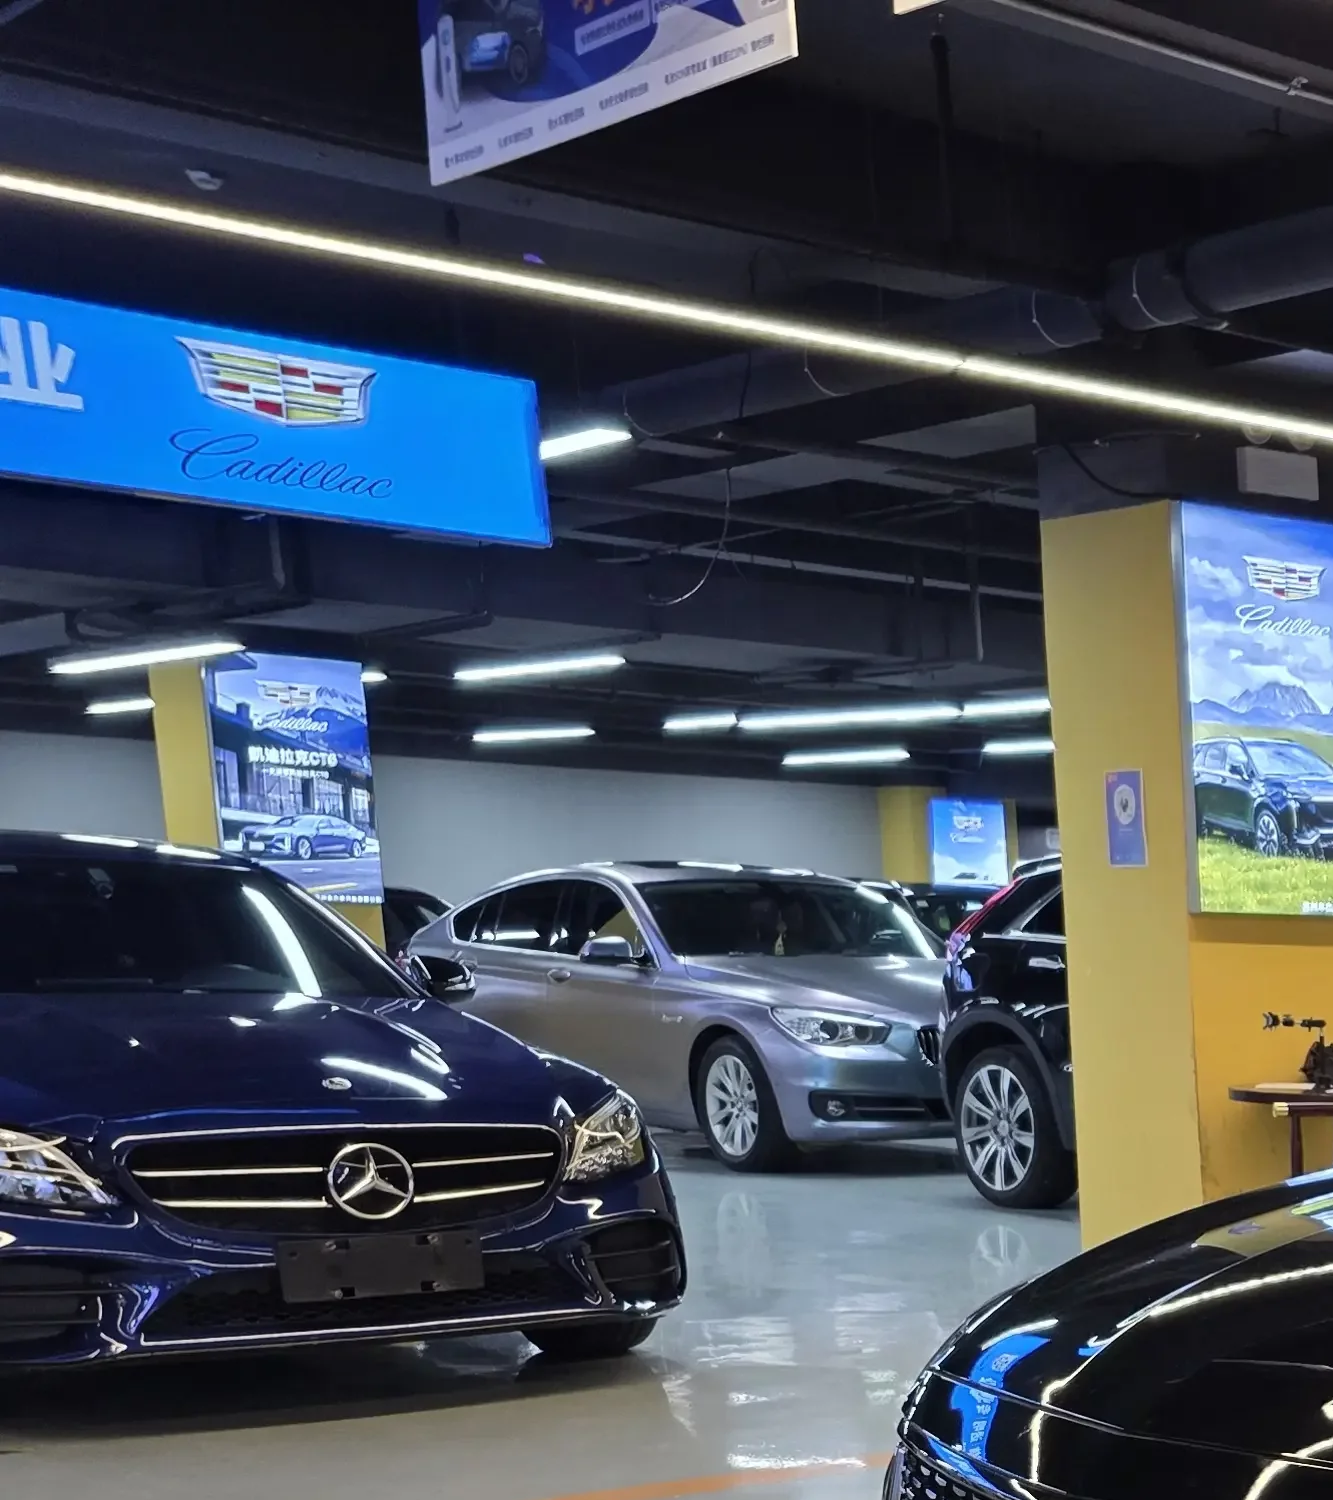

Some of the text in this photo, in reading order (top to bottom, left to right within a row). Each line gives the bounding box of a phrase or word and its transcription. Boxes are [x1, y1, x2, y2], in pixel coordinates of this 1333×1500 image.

[169, 428, 393, 498] Cadillac
[1235, 604, 1331, 636] Cadillac
[252, 712, 329, 733] Cadillac
